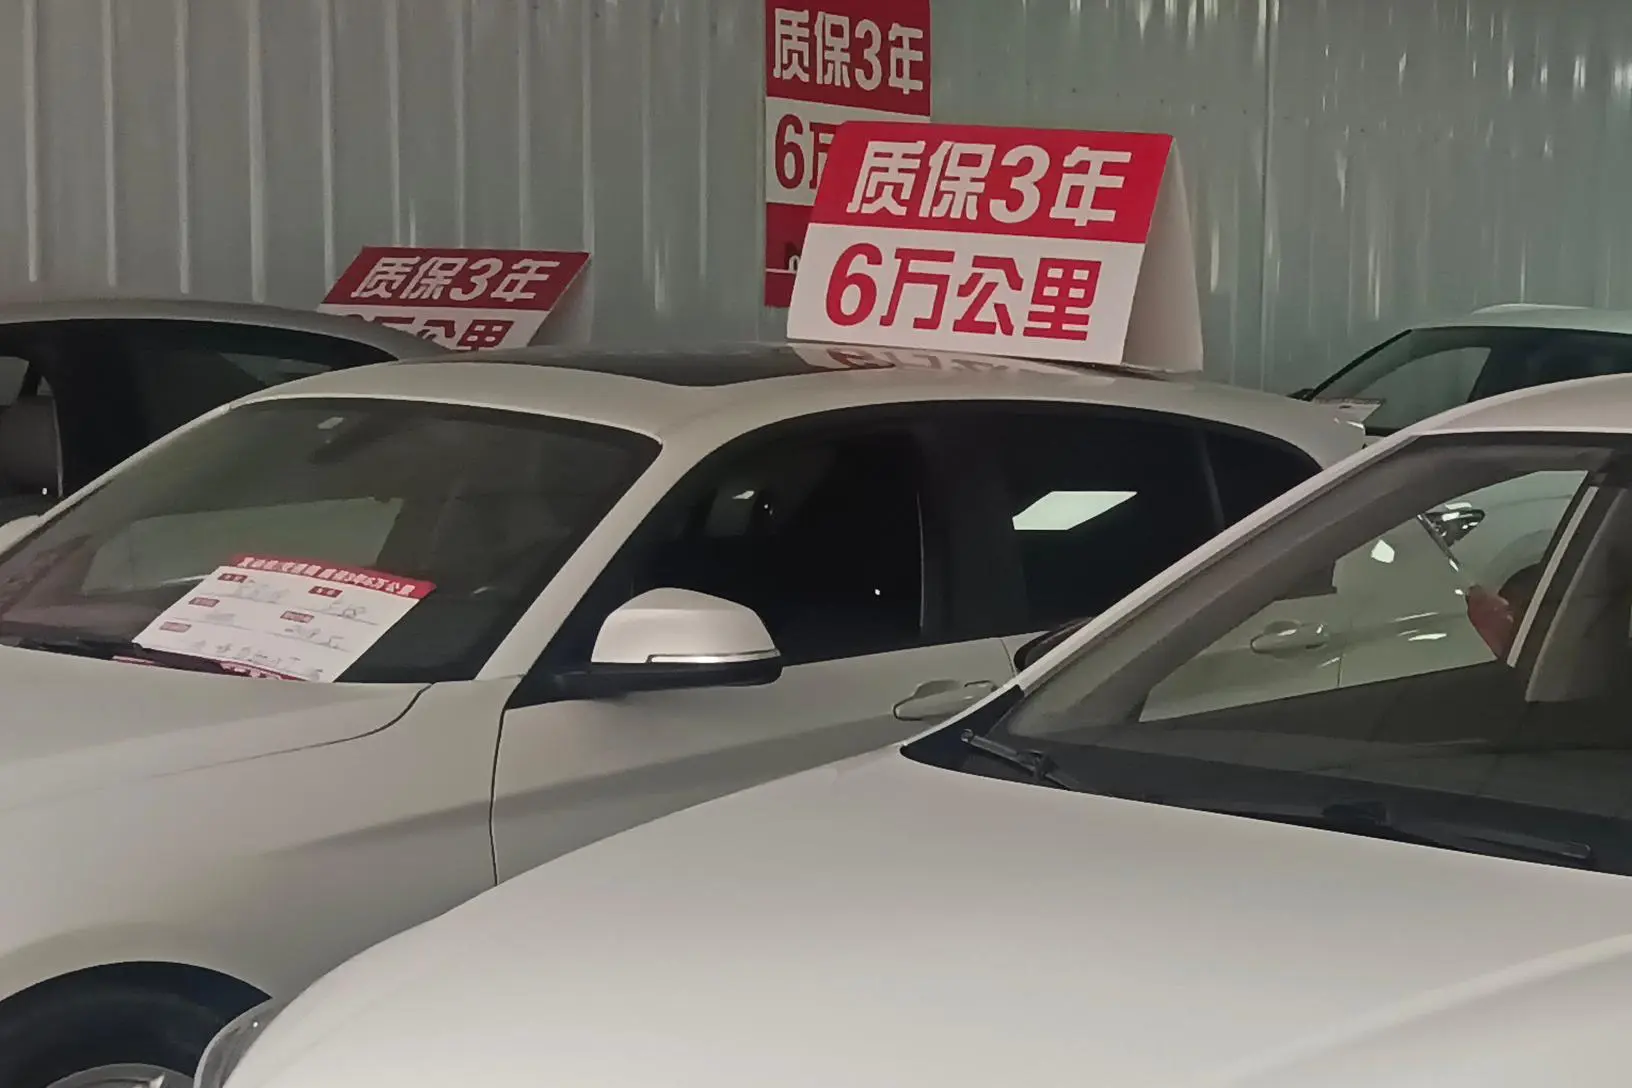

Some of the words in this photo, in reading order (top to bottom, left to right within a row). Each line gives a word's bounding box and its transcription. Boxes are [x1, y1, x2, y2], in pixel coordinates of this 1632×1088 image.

[772, 7, 924, 95] 质保3年
[847, 139, 1132, 228] 质保3年
[350, 255, 560, 303] 质保3年
[825, 242, 1102, 342] 6万公里
